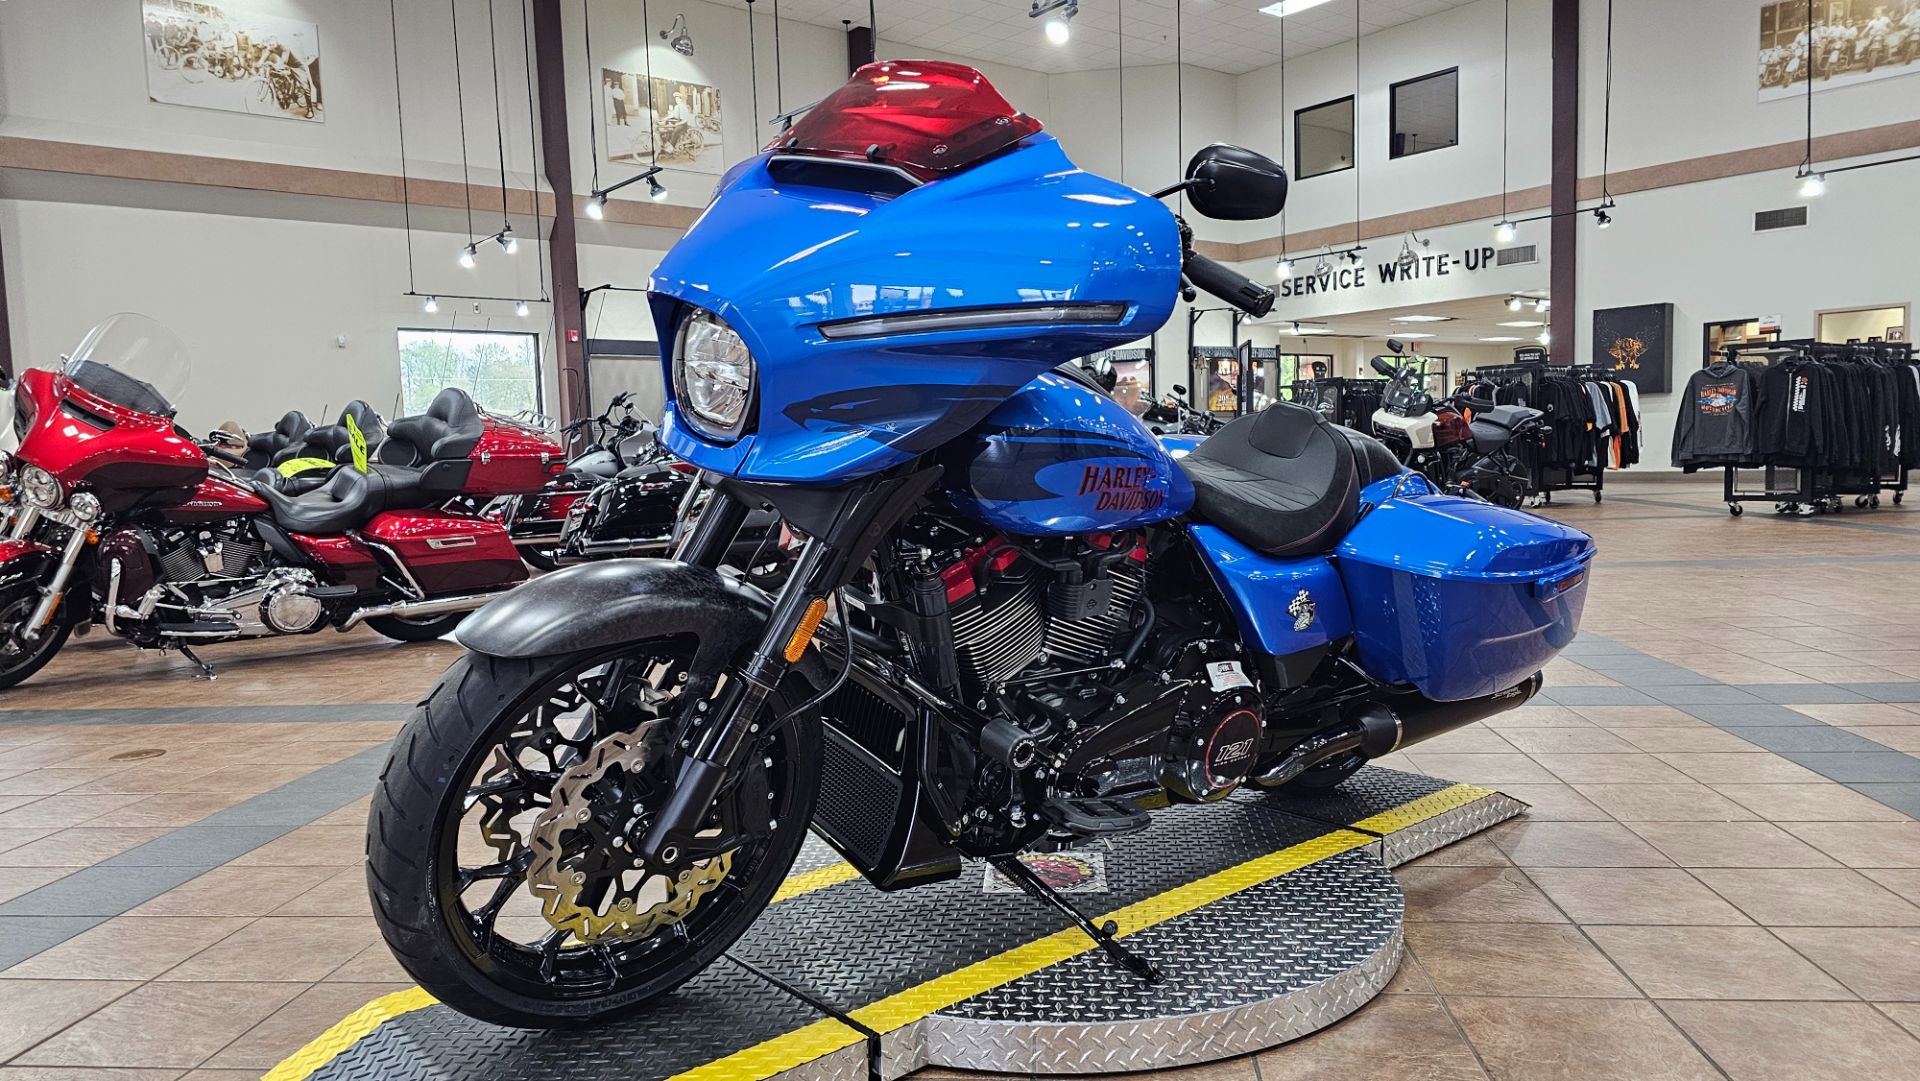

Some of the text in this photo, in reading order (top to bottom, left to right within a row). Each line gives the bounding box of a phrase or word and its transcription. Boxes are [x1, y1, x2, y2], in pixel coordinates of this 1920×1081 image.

[1281, 247, 1495, 297] SERVICE WRITE-UP
[1094, 488, 1165, 512] DAVIDSON
[1214, 737, 1254, 762] 121
